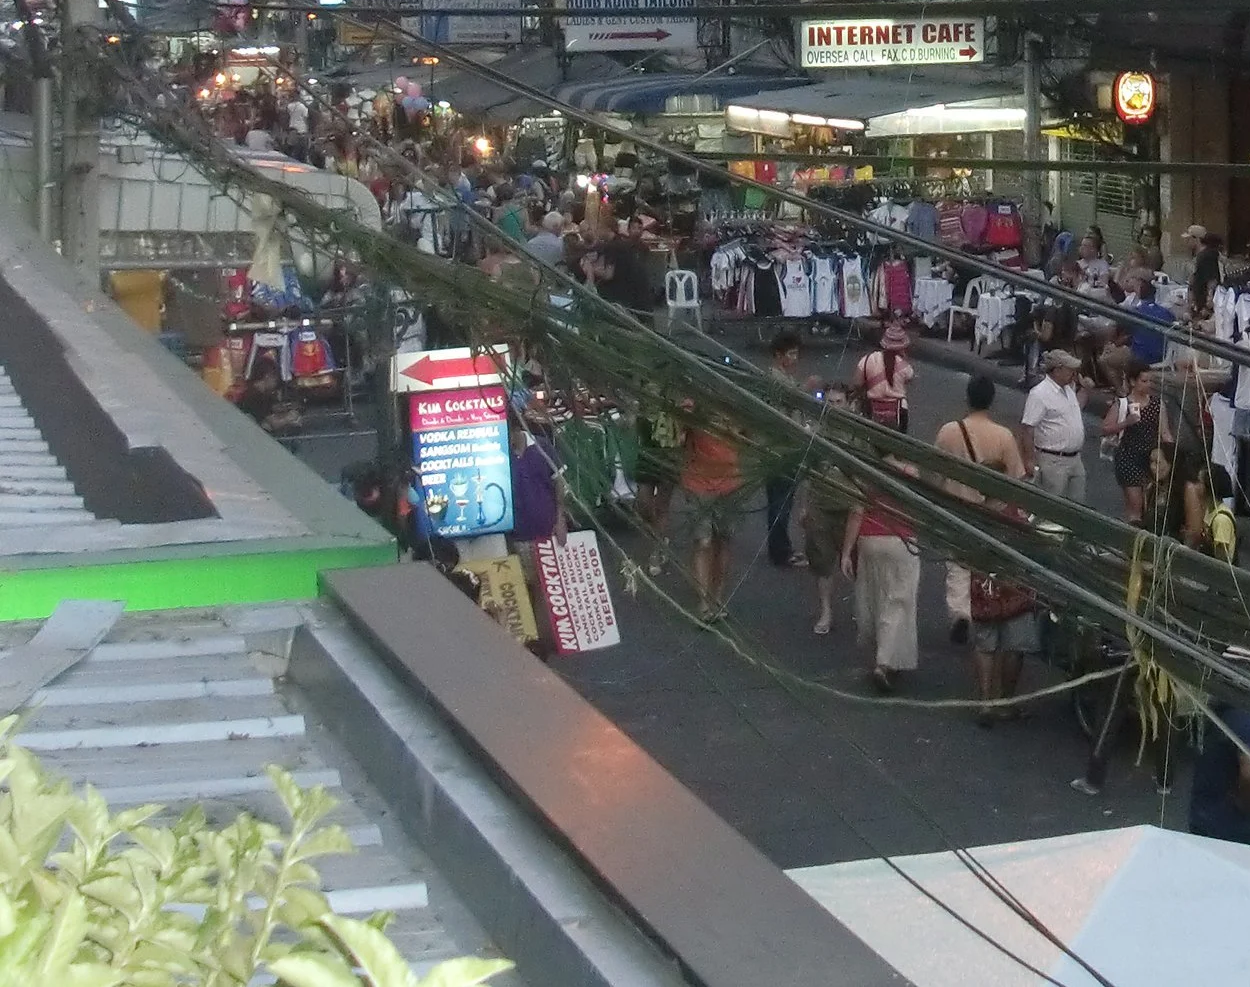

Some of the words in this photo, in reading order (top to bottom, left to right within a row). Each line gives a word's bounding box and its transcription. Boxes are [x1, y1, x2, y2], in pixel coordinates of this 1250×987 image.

[808, 24, 916, 47] INTERNET
[922, 23, 976, 44] CAFE
[807, 50, 850, 64] OVERSEA
[853, 50, 875, 62] CALL
[418, 402, 442, 416] KIM
[445, 396, 504, 413] COCKTAILS
[420, 431, 456, 444] VODKA
[420, 443, 471, 458] SANGSOM
[420, 456, 474, 472] COCKTAILS
[579, 541, 590, 570] BULL
[537, 539, 569, 616] COCKTAIL
[558, 553, 573, 599] STRONG
[586, 572, 596, 595] RED
[573, 585, 583, 611] SOM
[597, 582, 614, 626] BEER
[570, 603, 582, 632] VERY
[582, 586, 600, 642] COCKTAIL
[593, 597, 606, 636] VODKA
[556, 617, 578, 651] KIM
[580, 613, 592, 645] SANG
